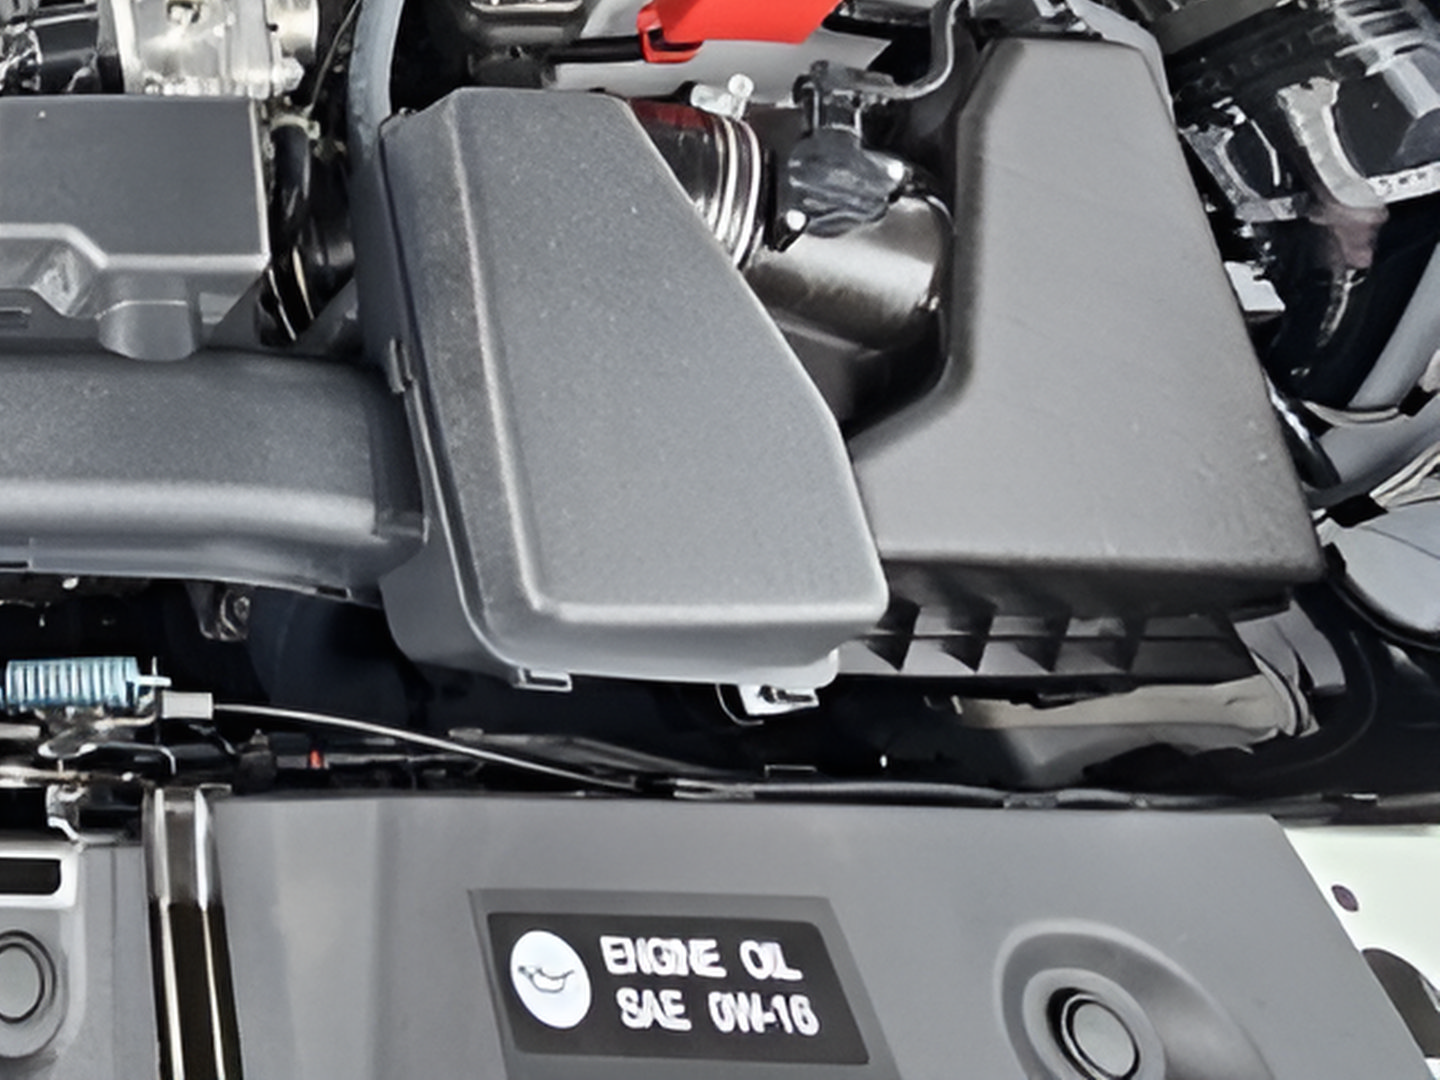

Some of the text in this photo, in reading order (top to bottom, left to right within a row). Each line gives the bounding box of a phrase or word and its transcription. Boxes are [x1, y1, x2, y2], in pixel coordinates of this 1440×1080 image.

[738, 939, 803, 981] OIL
[616, 987, 820, 1036] SAE 0W-16
